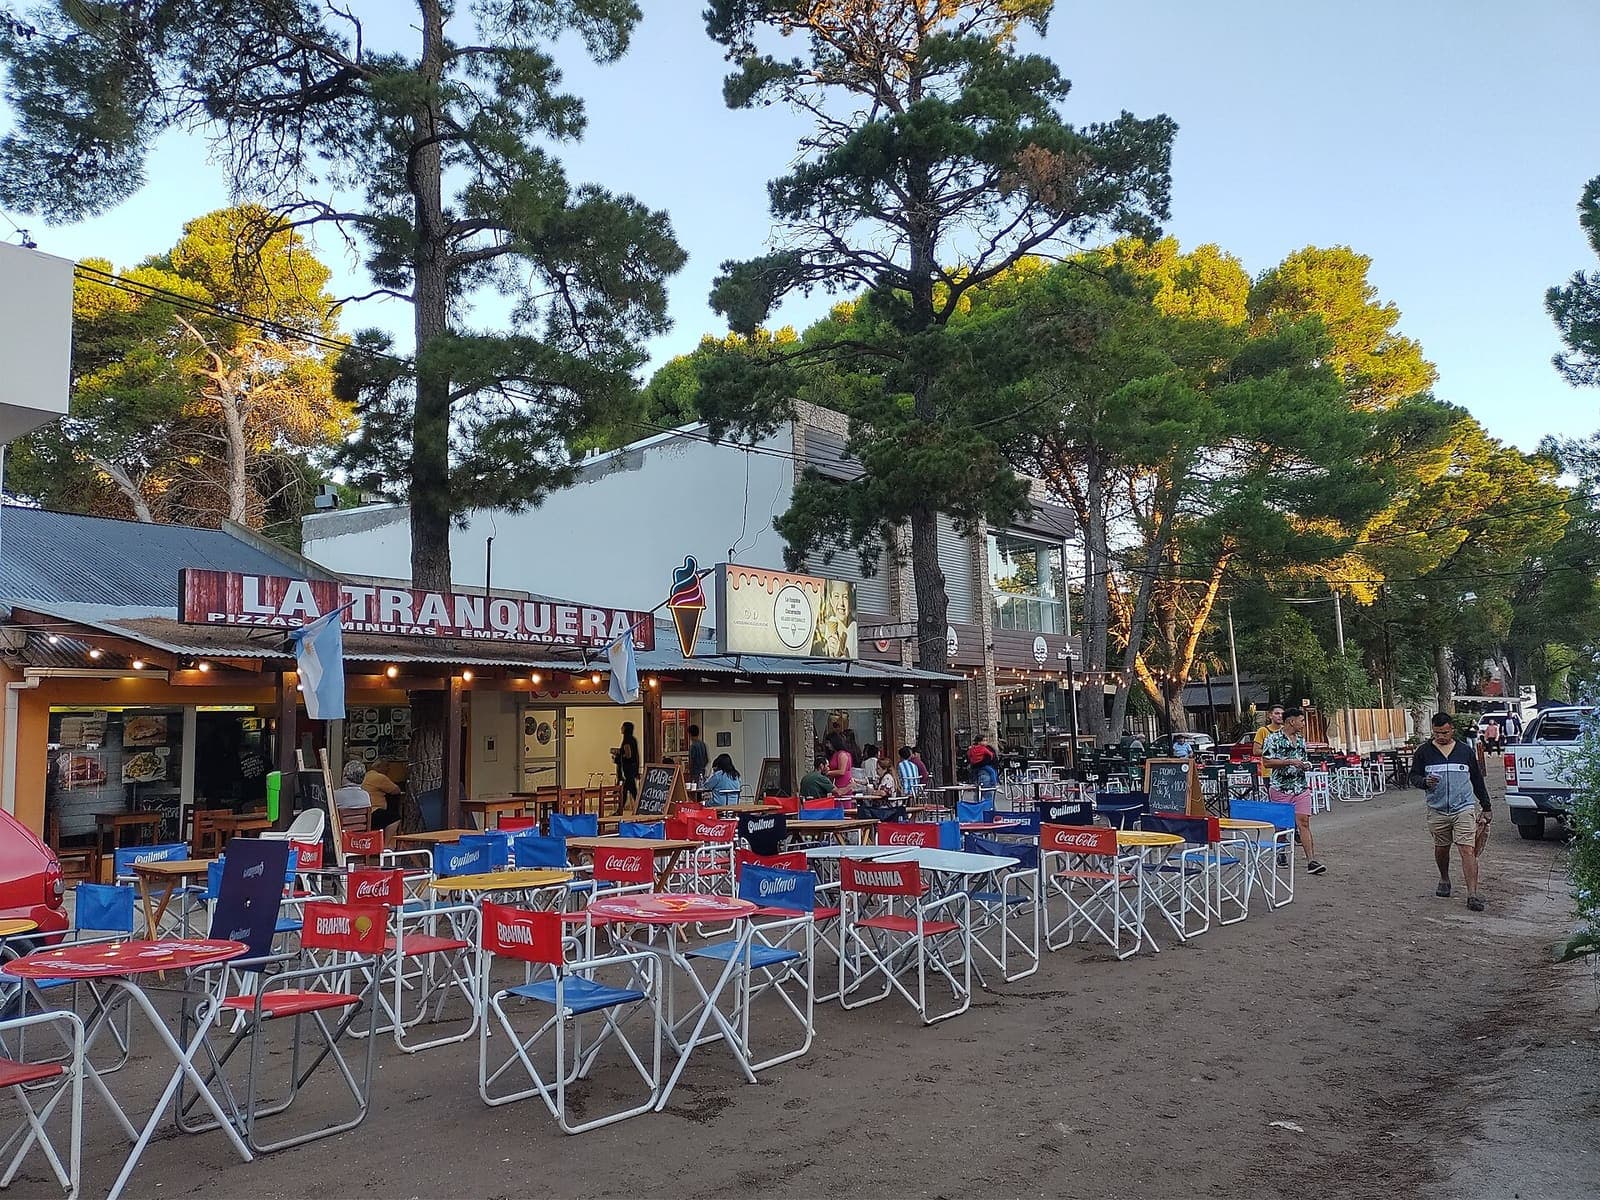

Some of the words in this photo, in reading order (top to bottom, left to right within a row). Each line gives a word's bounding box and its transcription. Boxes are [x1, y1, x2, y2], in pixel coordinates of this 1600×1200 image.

[242, 576, 321, 618] LA
[341, 585, 634, 639] TRANQUERA
[207, 612, 304, 628] PIZZAS
[460, 629, 576, 645] EMPANADAS
[1518, 757, 1535, 769] 110
[1054, 830, 1102, 848] Coca-Cola
[853, 868, 903, 887] BRAHMA
[316, 917, 351, 936] BRAHMA
[496, 921, 535, 946] BRAHMA
